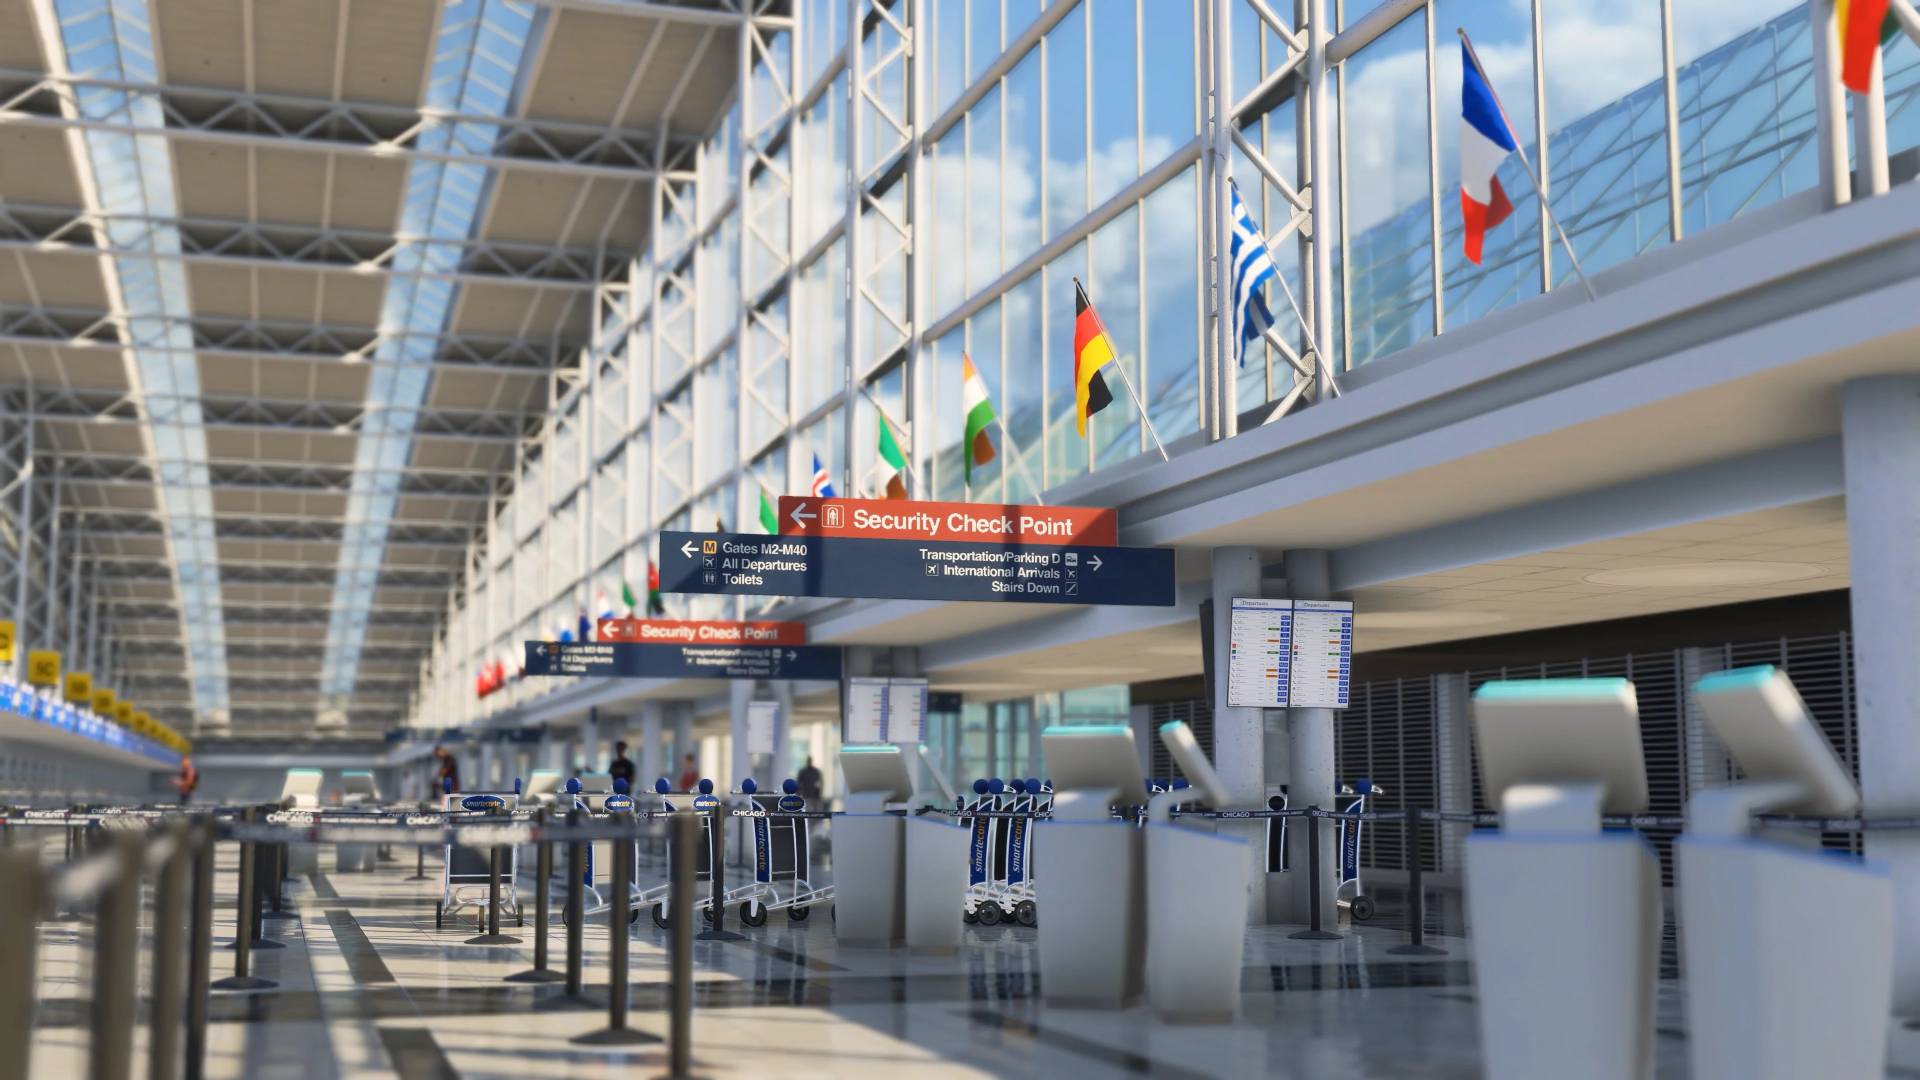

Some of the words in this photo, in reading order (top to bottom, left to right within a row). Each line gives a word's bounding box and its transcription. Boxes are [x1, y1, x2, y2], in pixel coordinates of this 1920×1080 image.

[853, 509, 940, 535] Security
[947, 512, 1014, 534] Check
[1020, 516, 1073, 536] Point
[704, 543, 715, 554] M
[722, 541, 758, 554] Gates
[761, 543, 808, 556] M2-M40
[919, 548, 1049, 566] Transportation/Parking
[1052, 553, 1061, 564] D
[722, 557, 738, 569] All
[741, 558, 807, 573] Departures
[943, 564, 1014, 578] International
[1017, 567, 1060, 579] Arrivals
[722, 573, 763, 586] Toilets
[991, 581, 1024, 593] Stairs
[1027, 583, 1060, 594] Down
[641, 623, 694, 639] Security
[699, 625, 741, 640] Check
[744, 625, 779, 640] Point
[561, 655, 571, 663] All
[25, 811, 65, 819] CHICAGO
[266, 813, 314, 824] CHICAGO
[732, 809, 766, 817] CHICAGO
[941, 809, 972, 817] CHICAGO
[758, 817, 766, 871] martecarte
